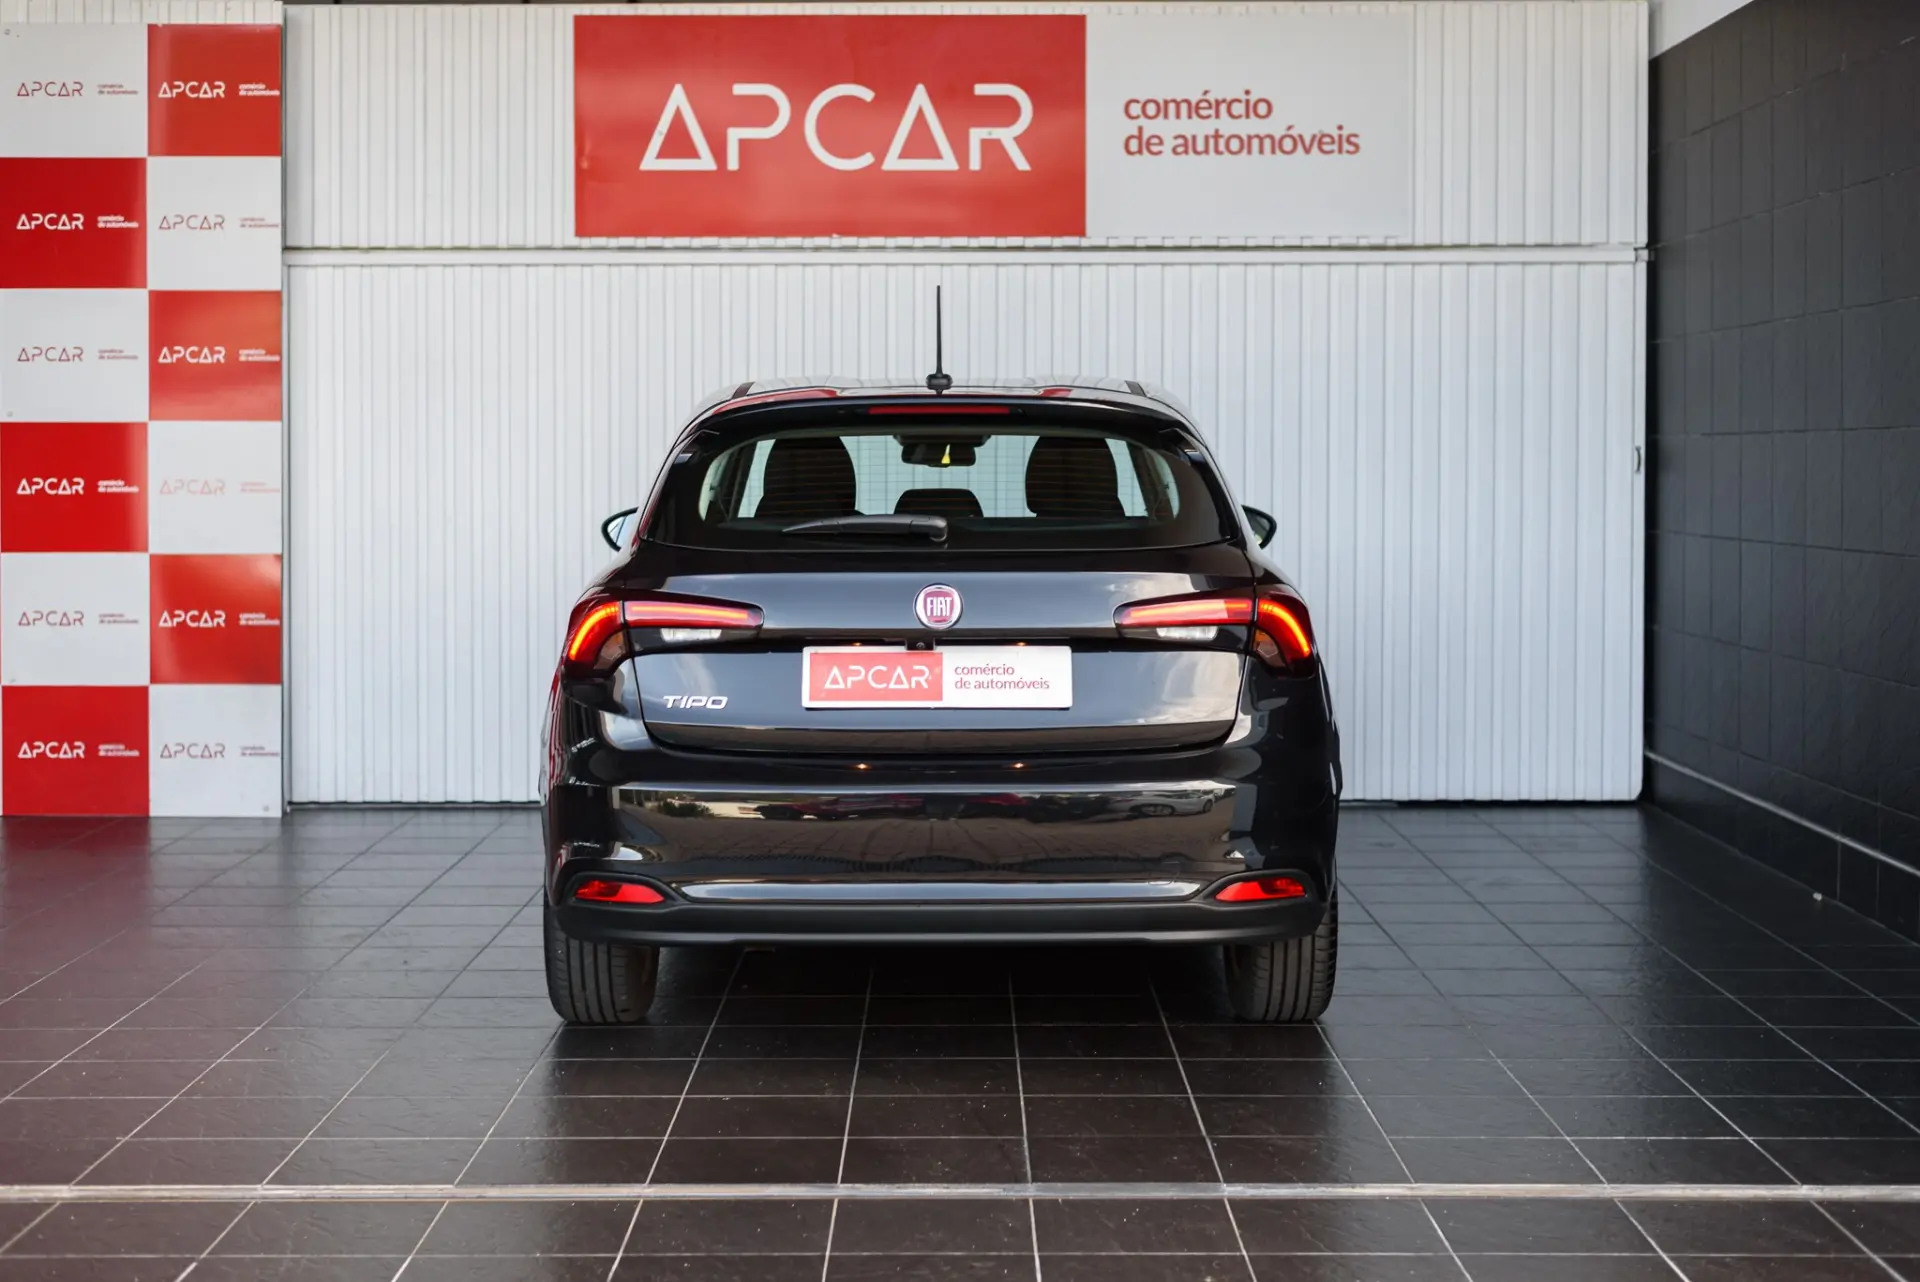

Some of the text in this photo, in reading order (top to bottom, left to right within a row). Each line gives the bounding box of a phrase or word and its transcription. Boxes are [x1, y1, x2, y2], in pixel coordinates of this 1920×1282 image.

[17, 81, 83, 97] APCAR
[158, 81, 226, 98] APCAR
[1123, 90, 1273, 120] comércio
[640, 83, 1034, 171] APCAR
[1123, 125, 1360, 156] de automóveis
[16, 213, 84, 230] APCAR
[159, 214, 225, 230] APCAR
[17, 346, 84, 362] APCAR
[158, 346, 226, 363] APCAR
[16, 477, 85, 495] APCAR
[926, 596, 952, 617] FIAT
[18, 610, 85, 627] APCAR
[158, 609, 226, 628] APCAR
[823, 665, 931, 690] APCAR
[954, 663, 1015, 676] comércio
[954, 676, 1050, 690] de automóveis
[662, 695, 729, 710] TIPO
[17, 741, 85, 759] APCAR
[159, 743, 226, 759] APCAR
